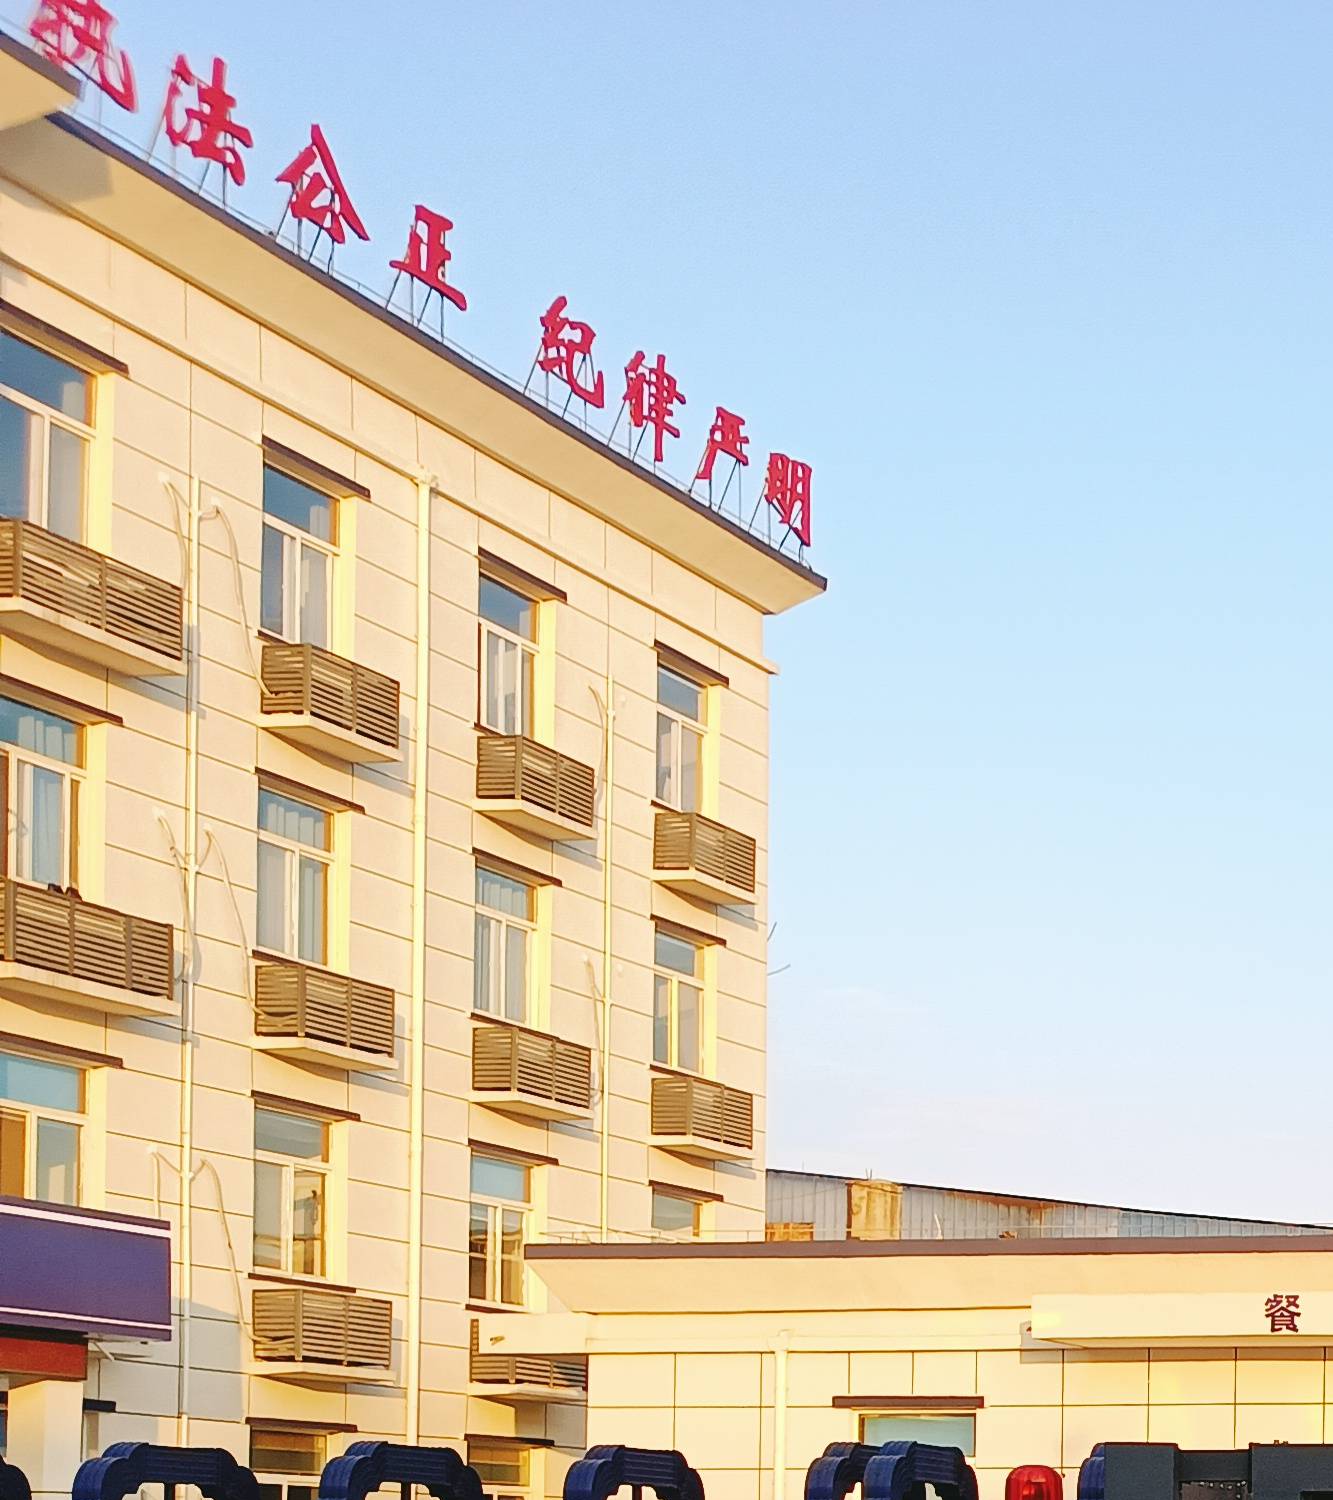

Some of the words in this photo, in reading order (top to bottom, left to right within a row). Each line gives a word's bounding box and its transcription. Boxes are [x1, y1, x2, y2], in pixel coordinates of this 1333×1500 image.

[29, 0, 467, 311] 执法公正
[536, 296, 812, 547] 纪律严明
